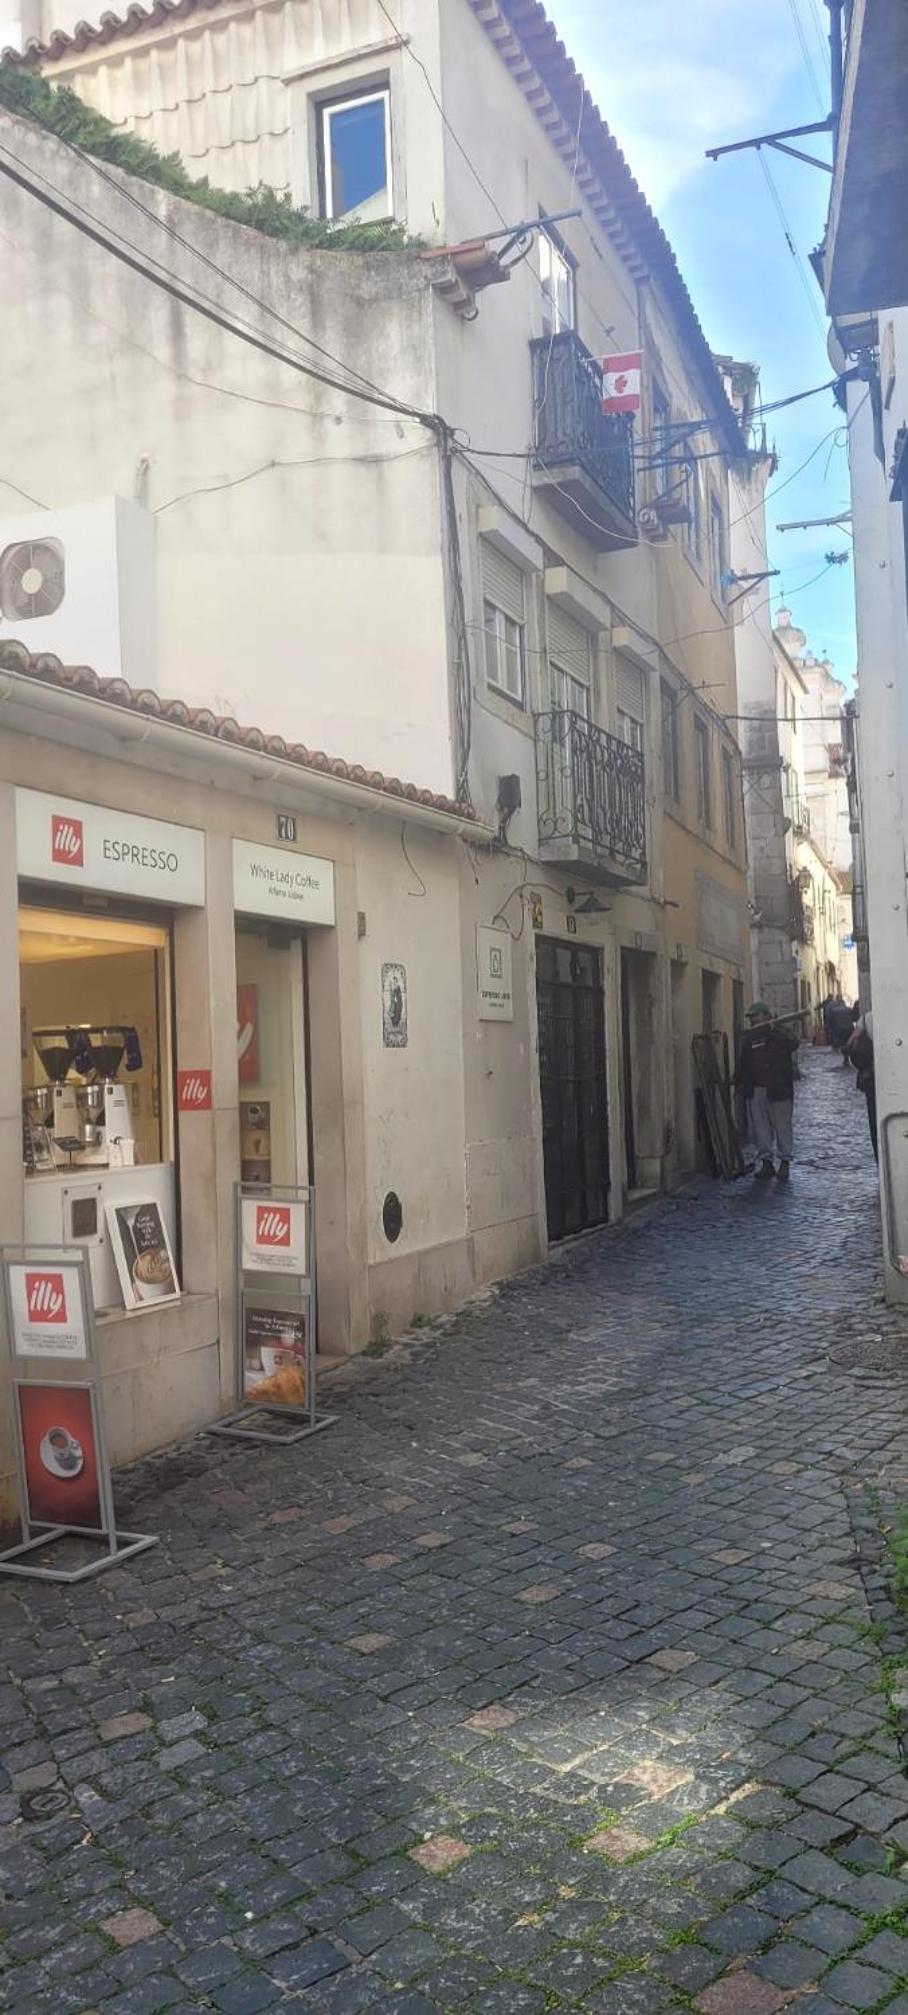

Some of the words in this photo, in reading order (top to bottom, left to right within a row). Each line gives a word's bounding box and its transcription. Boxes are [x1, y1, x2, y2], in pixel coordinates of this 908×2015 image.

[55, 823, 81, 859] illy
[280, 816, 294, 841] 70
[103, 839, 178, 873] ESPRESSO
[250, 863, 274, 881] White
[275, 868, 294, 888] Lady
[295, 872, 320, 890] Coffee
[182, 1078, 207, 1105] illy
[259, 1212, 288, 1243] illy
[30, 1280, 63, 1319] illy
